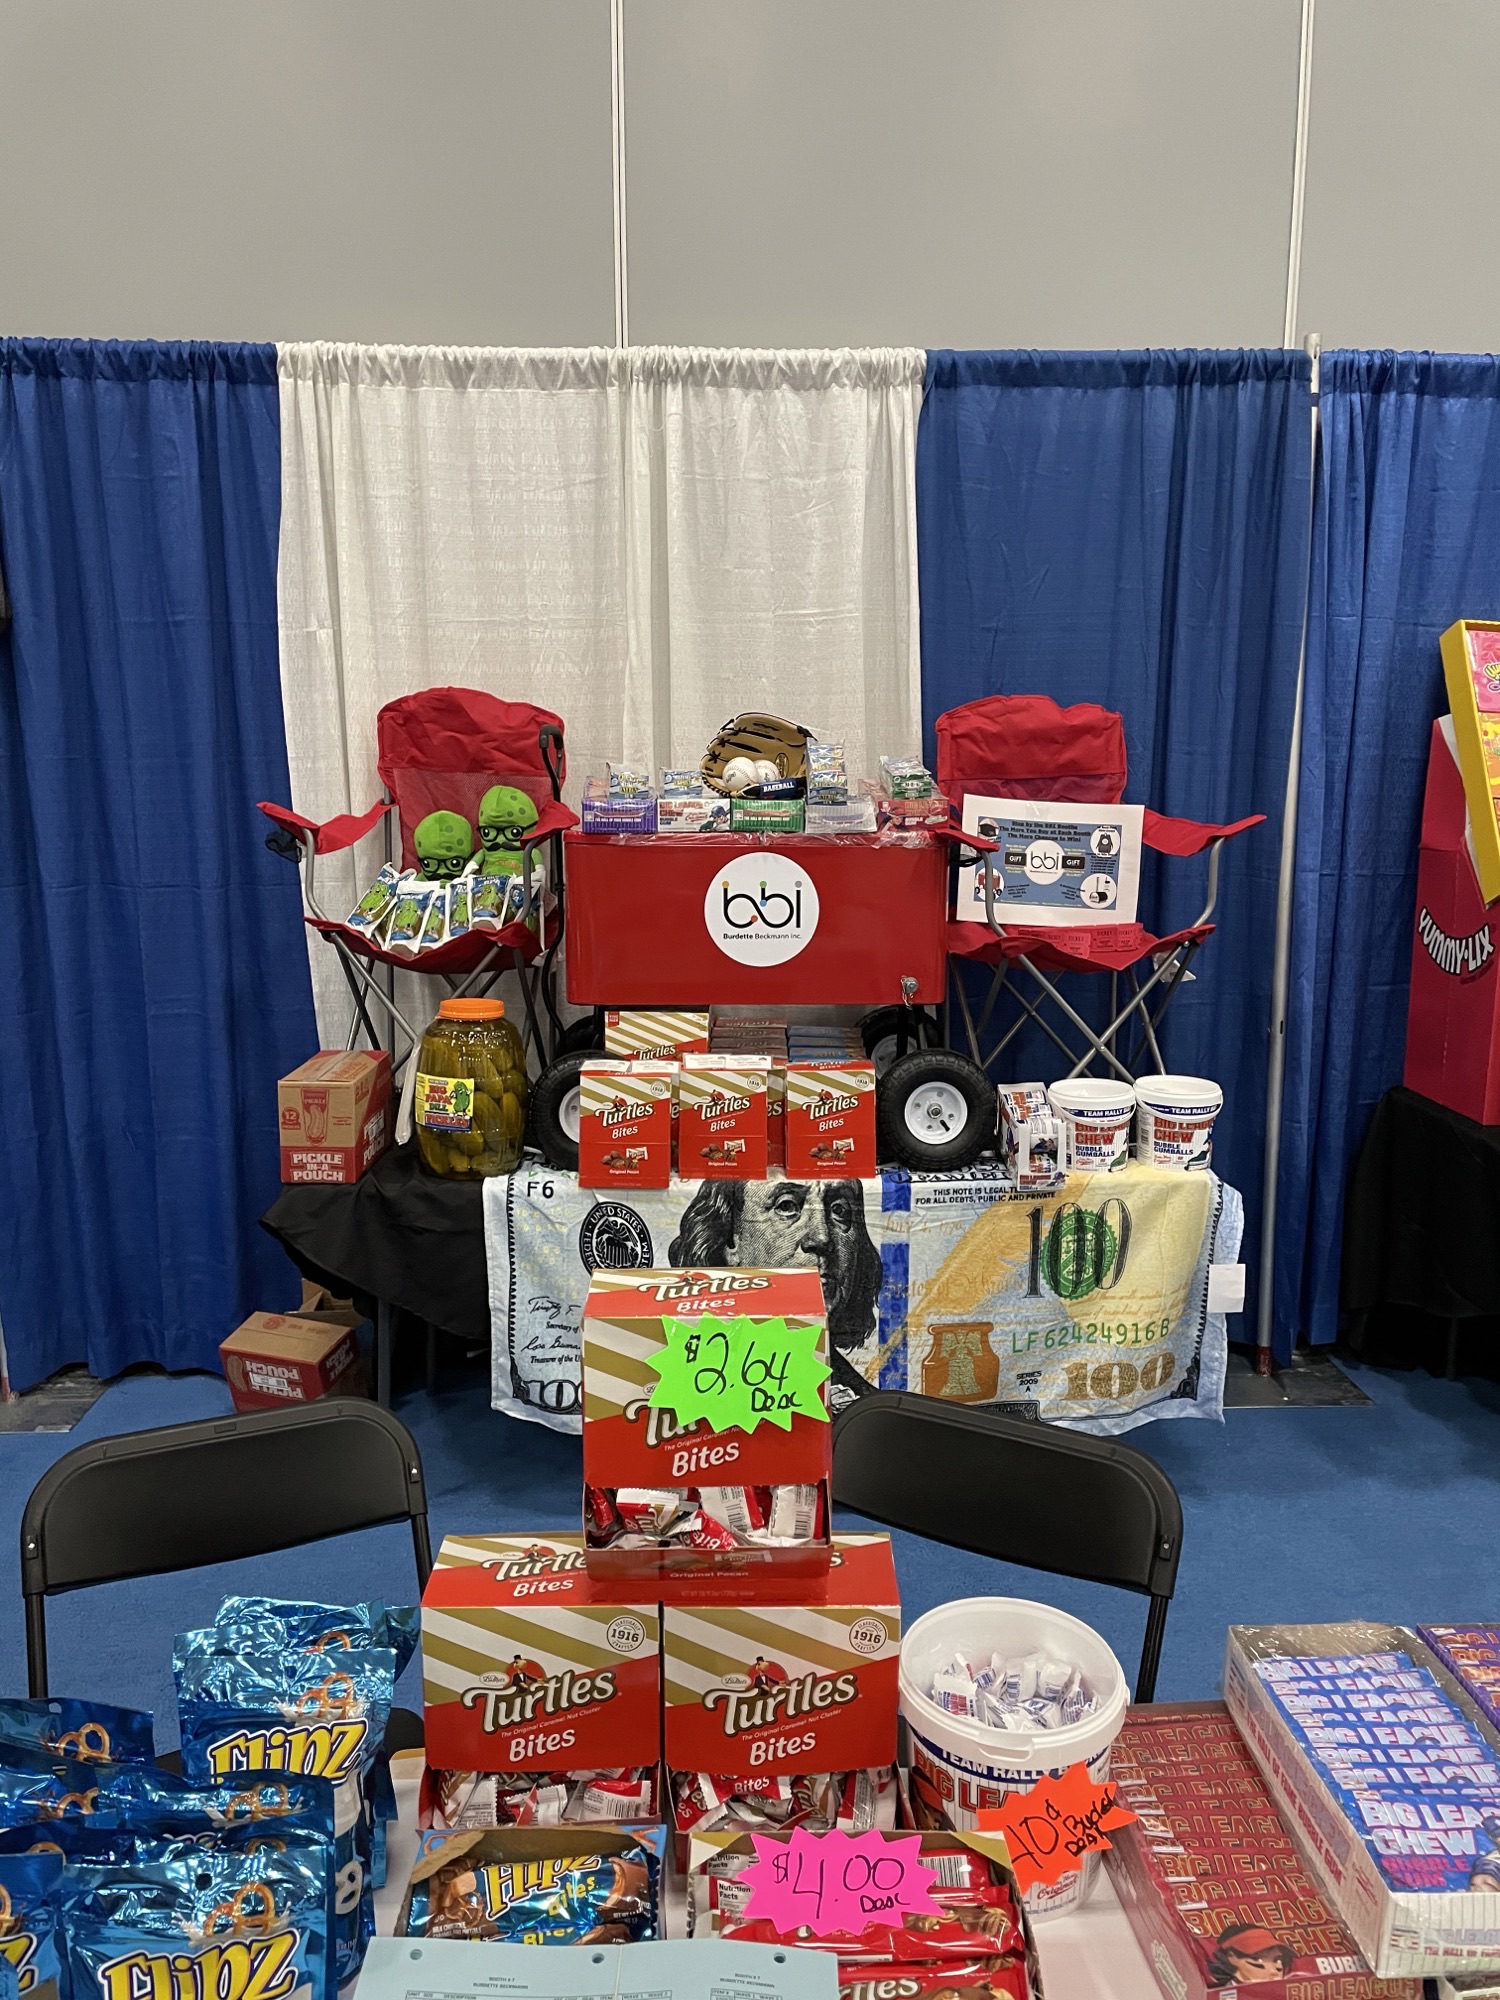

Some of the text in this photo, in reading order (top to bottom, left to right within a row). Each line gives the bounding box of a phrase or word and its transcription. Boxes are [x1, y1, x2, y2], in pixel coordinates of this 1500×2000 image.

[762, 781, 794, 793] BASEBALL
[722, 880, 803, 929] bbi
[723, 932, 754, 940] Burdette
[754, 932, 790, 940] Beckmann
[633, 1044, 676, 1061] Turtles
[425, 1093, 453, 1106] PAPA
[428, 1103, 449, 1112] DILL
[801, 1095, 859, 1121] Turtles
[285, 1111, 297, 1120] 12
[595, 1103, 654, 1127] Turtles
[693, 1096, 751, 1121] Turtles
[1083, 1108, 1123, 1117] TEAM RALLY
[425, 1113, 470, 1128] PICKLES
[710, 1118, 736, 1132] Bites
[818, 1118, 844, 1132] Bites
[1075, 1122, 1099, 1132] BIG
[1154, 1116, 1177, 1129] BIG
[611, 1125, 638, 1139] Bites
[1075, 1132, 1116, 1145] CHEW
[1154, 1129, 1195, 1143] CHEW
[1153, 1141, 1181, 1149] BUBBLE
[1153, 1146, 1194, 1155] GUMBALLS
[293, 1152, 343, 1165] PICKLE
[293, 1170, 344, 1182] POUCH
[527, 1181, 555, 1198] F6
[952, 1188, 973, 1196] NOTE
[975, 1187, 982, 1195] IS
[915, 1192, 1056, 1205] FOR ALL DEBTS, PUBLIC AND PRIVATE
[616, 1207, 642, 1233] STATES
[1023, 1198, 1133, 1299] 100
[638, 1276, 770, 1302] Turtles
[676, 1297, 737, 1313] Bites
[546, 1321, 572, 1332] Secretary
[530, 1355, 573, 1365] Treasurer of the
[685, 1332, 792, 1397] $2.64
[245, 1360, 300, 1380] POUCH
[1016, 1370, 1042, 1380] SERIES
[1060, 1352, 1176, 1401] 100
[1019, 1378, 1039, 1386] 2009
[677, 1437, 702, 1449] Original
[672, 1442, 740, 1477] Bites
[482, 1550, 588, 1581] Turtle
[512, 1578, 574, 1597] Bites
[611, 1628, 640, 1643] 1916
[853, 1629, 882, 1645] 1916
[1255, 1654, 1399, 1682] BIG LEAGUE
[462, 1670, 615, 1733] Turtles
[703, 1673, 858, 1735] Turtles
[501, 1706, 601, 1738] The Original Caramel Nut Cluster
[754, 1727, 780, 1738] Original
[780, 1720, 808, 1731] Caramel
[808, 1715, 820, 1723] Nut
[820, 1709, 842, 1719] Cluster
[509, 1729, 576, 1763] Bites
[750, 1732, 817, 1767] Bites
[941, 1749, 1050, 1780] TEAM RALLY
[735, 1776, 770, 1794] Bites
[1257, 1737, 1344, 1886] HALL OF FAME BUBBLE GUM
[1358, 1800, 1422, 1828] BIG
[1371, 1828, 1477, 1857] CHEW
[1156, 1854, 1212, 1878] BIG
[1381, 1856, 1472, 1873] BUBBLE
[774, 1851, 905, 1921] $4.00
[1037, 1873, 1077, 1900] Original
[1392, 1871, 1447, 1888] GUM
[548, 1876, 596, 1916] Bites
[719, 1884, 751, 1893] Nutrition
[720, 1892, 738, 1900] Facts
[1181, 1908, 1239, 1938] BIG
[1424, 1946, 1478, 1957] THE HALL OF
[99, 1928, 301, 2000] Flipz
[1286, 1977, 1418, 2000] BIG LEAGUE
